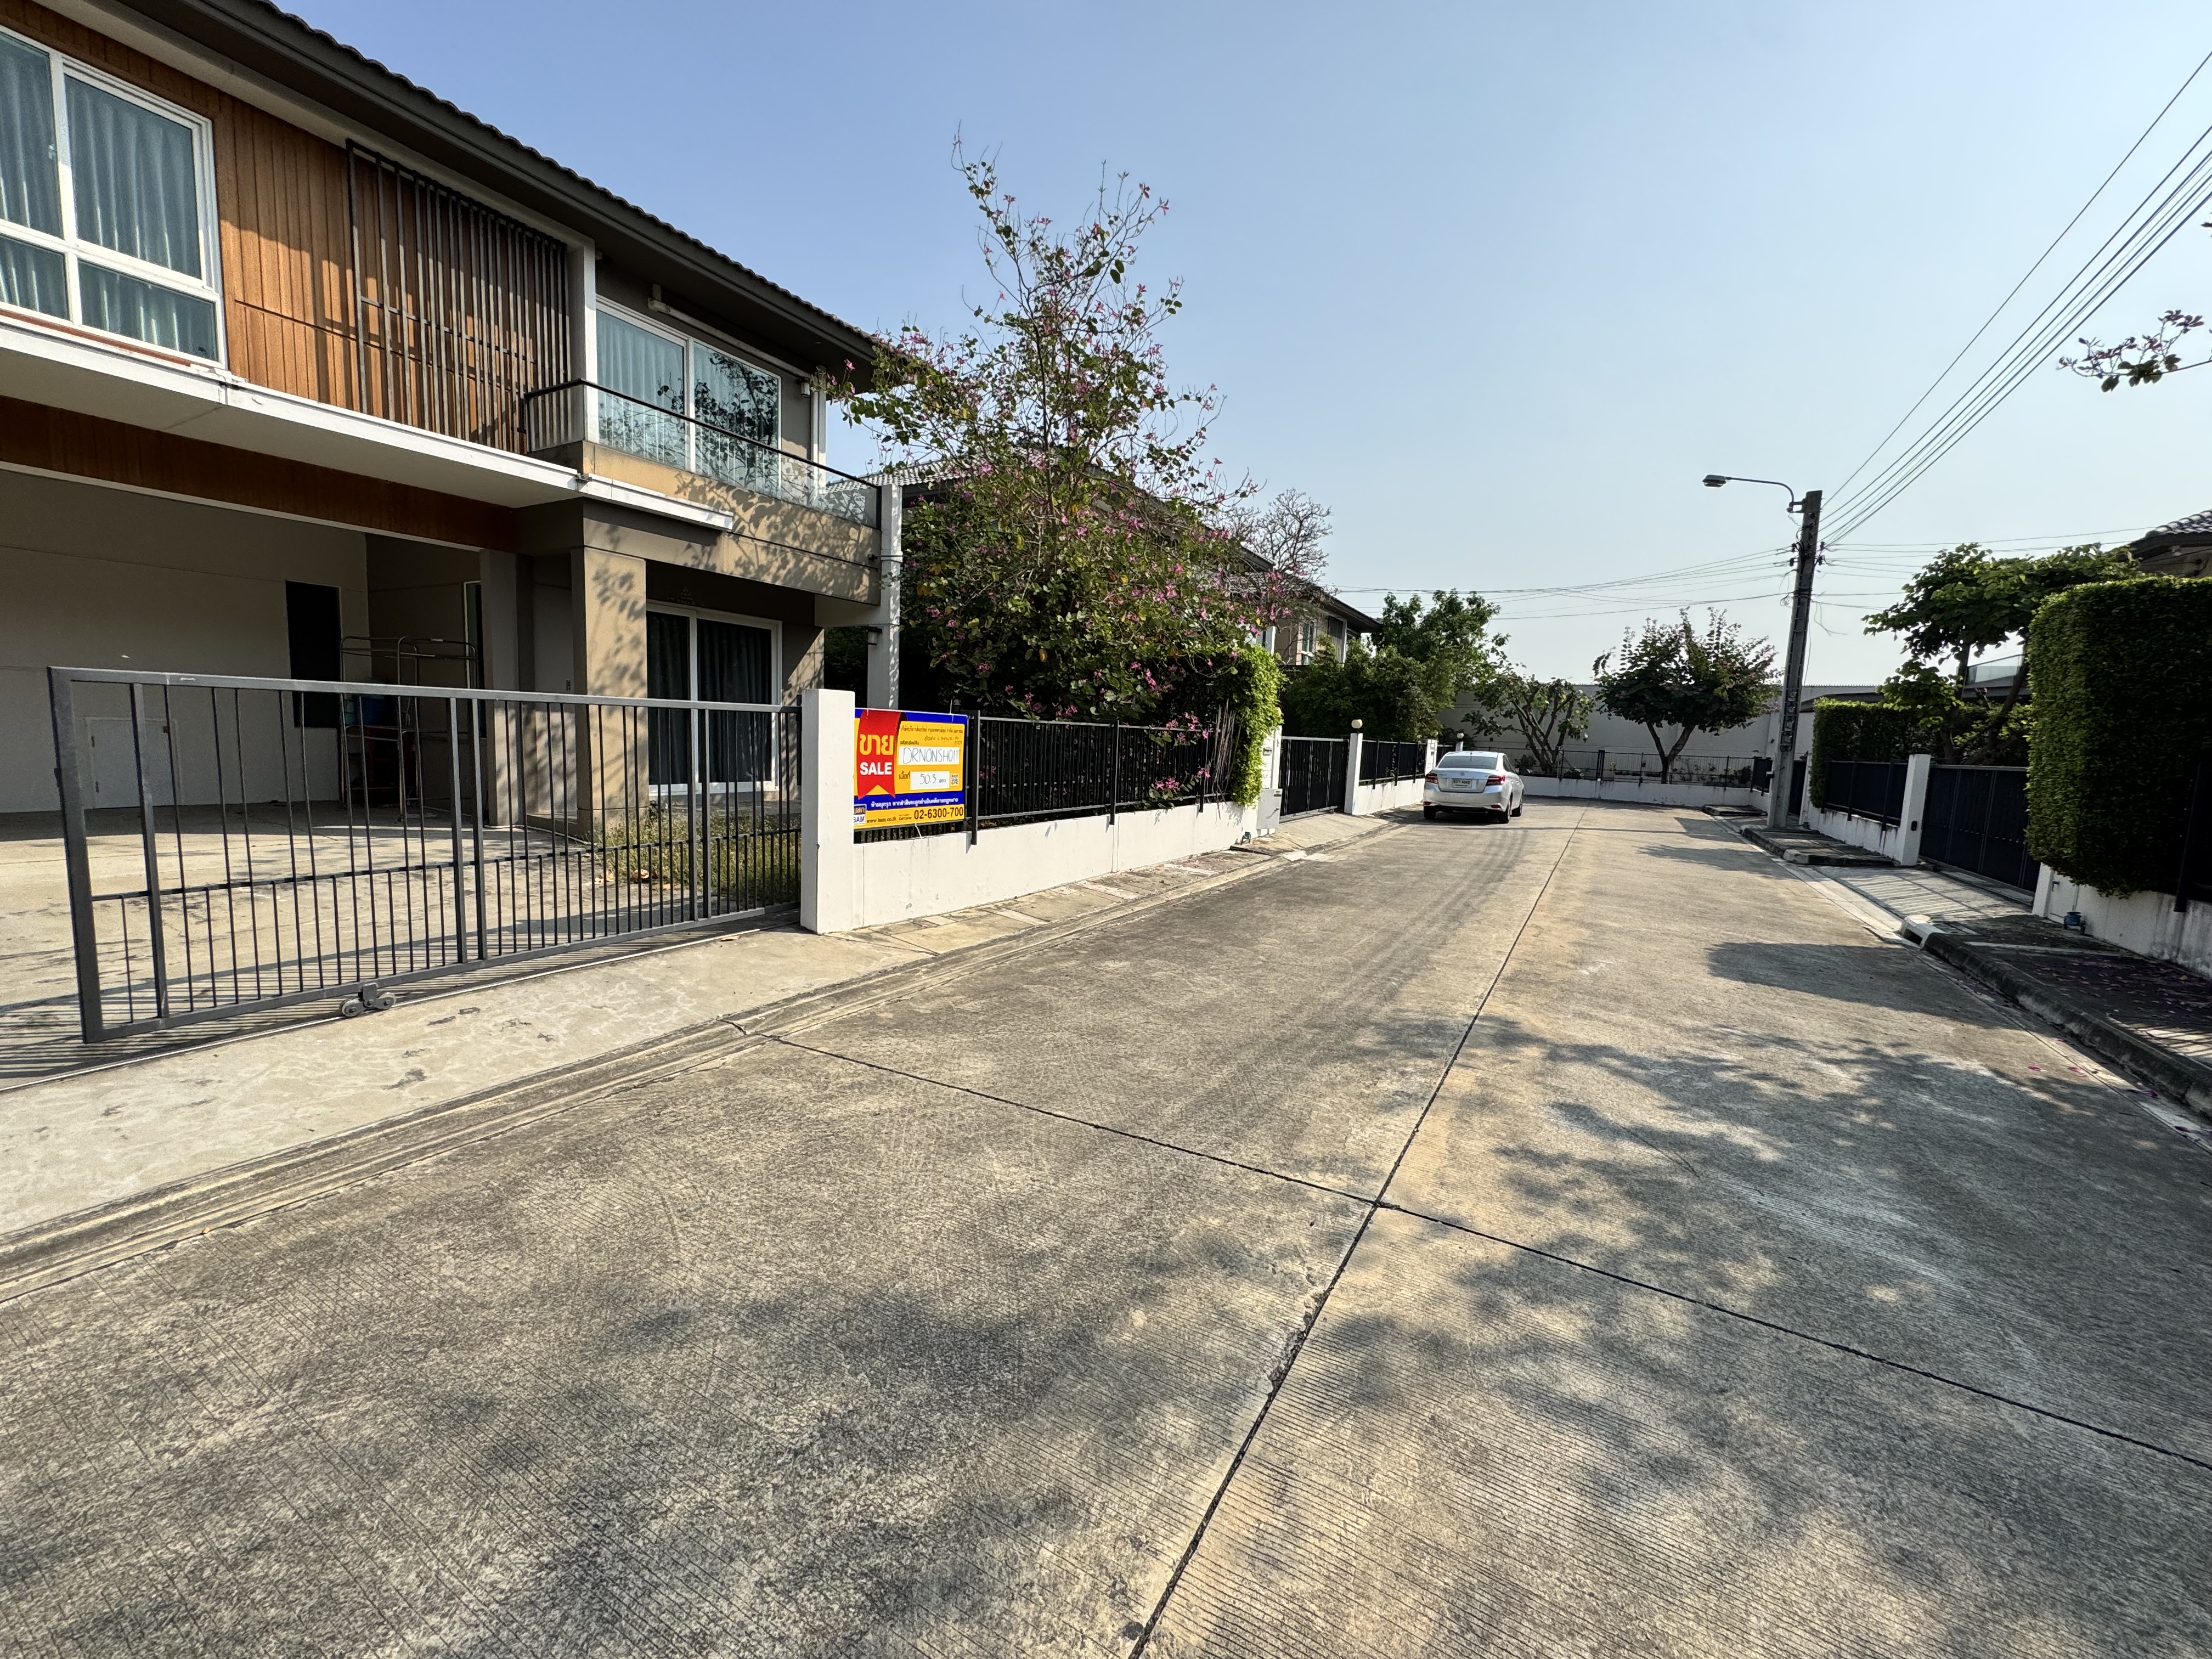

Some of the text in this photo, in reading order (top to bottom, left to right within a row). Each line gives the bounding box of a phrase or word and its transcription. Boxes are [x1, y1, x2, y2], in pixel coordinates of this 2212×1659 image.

[859, 734, 894, 755] ขาย
[859, 761, 893, 776] SALE
[914, 806, 964, 820] 02-6300-700
